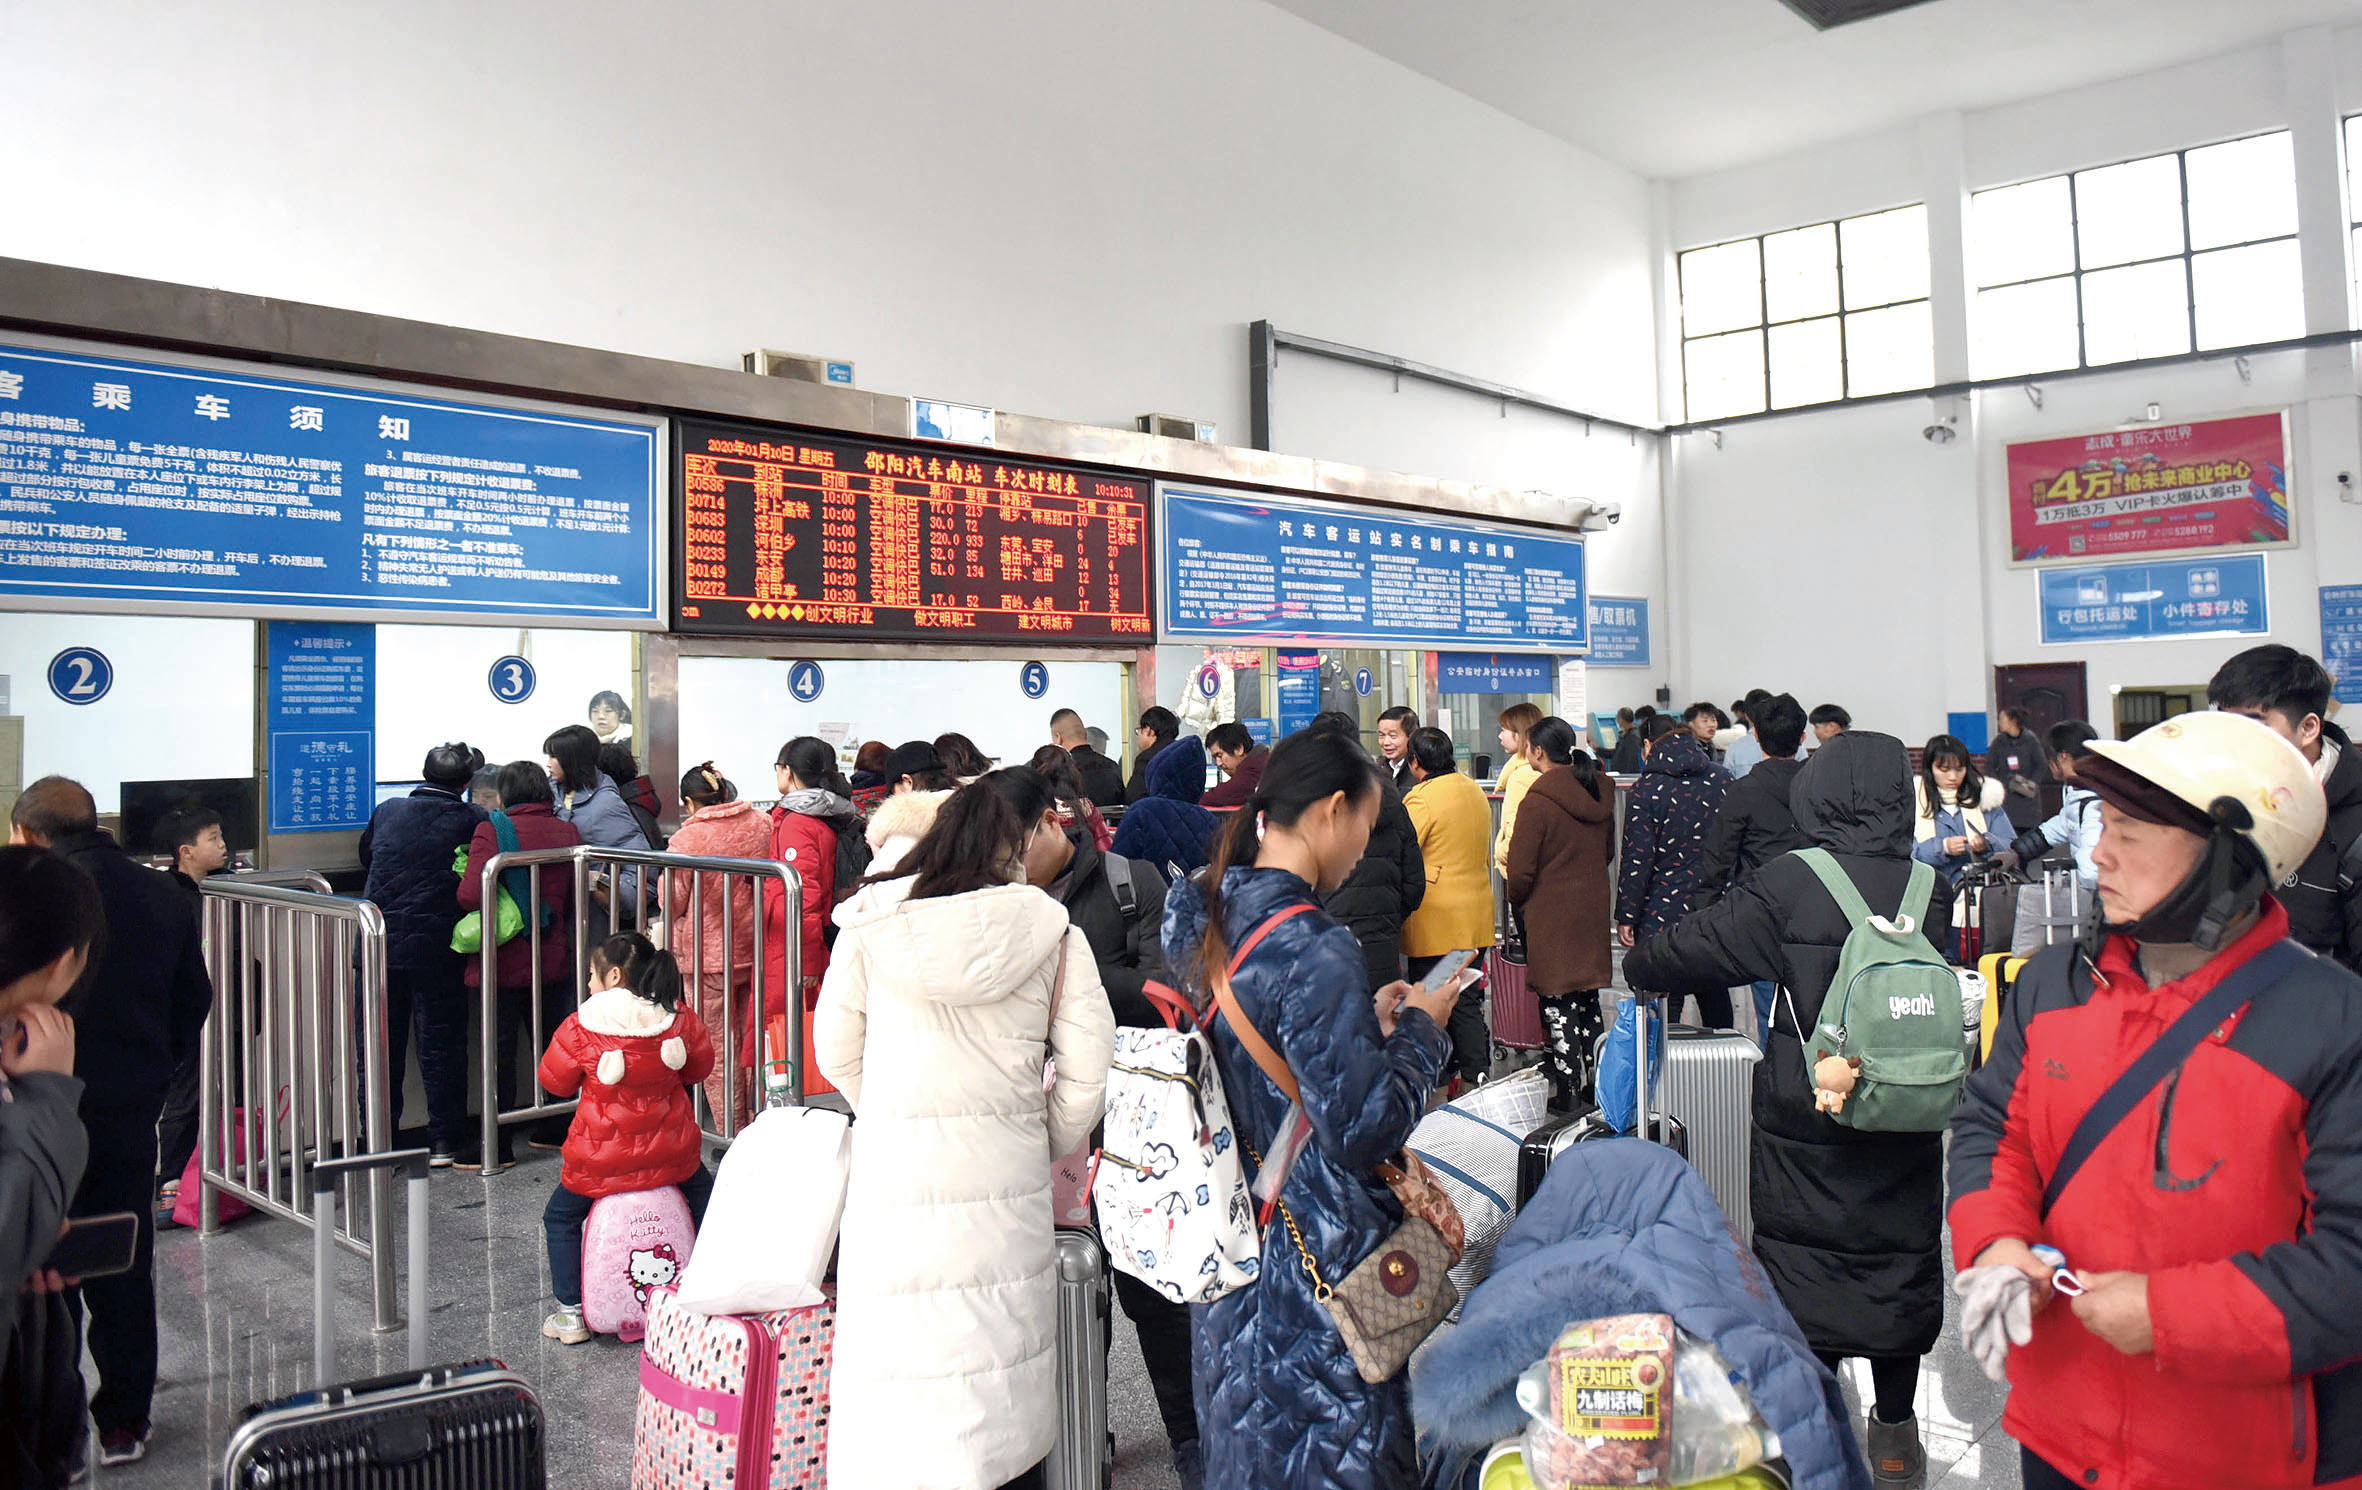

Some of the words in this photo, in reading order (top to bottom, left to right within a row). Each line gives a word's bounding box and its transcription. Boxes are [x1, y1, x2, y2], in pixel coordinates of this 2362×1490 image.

[707, 439, 796, 463] 2020年01月10日
[798, 447, 835, 468] 星期五
[687, 456, 718, 475] 车次
[821, 473, 849, 489] 时间
[868, 478, 895, 494] 车型
[928, 484, 954, 501] 票价
[965, 486, 988, 504] 里程
[864, 450, 983, 484] 邵阳汽车南站
[994, 465, 1080, 495] 车次时刻表
[687, 477, 727, 493] B0586
[821, 490, 857, 506] 10:00
[929, 501, 955, 515] 77.0
[965, 505, 984, 518] 213
[1076, 515, 1089, 527] 10
[1094, 483, 1134, 499] 10:10:31
[687, 493, 727, 511] B0714
[821, 506, 857, 522] 10:00
[929, 515, 955, 530] 30.0
[965, 520, 979, 533] 72
[687, 510, 727, 528] B0683
[754, 514, 784, 534] 深圳
[821, 522, 857, 538] 10:00
[929, 531, 961, 546] 220.0
[965, 535, 984, 548] 933
[1107, 545, 1119, 558] 20
[687, 527, 727, 545] B0602
[821, 538, 857, 554] 10:10
[930, 547, 955, 561] 32.0
[965, 549, 979, 562] 85
[1077, 557, 1089, 570] 24
[1107, 559, 1115, 572] 4
[1279, 520, 1515, 559] 汽车客运站实名制乘车指南
[687, 545, 727, 562] B0233
[822, 555, 858, 571] 10:20
[930, 562, 956, 576] 51.0
[966, 565, 985, 578] 134
[1078, 572, 1090, 585] 12
[1108, 573, 1120, 586] 13
[687, 562, 728, 580] B0149
[755, 566, 785, 585] 成都
[822, 571, 858, 587] 10:20
[1108, 587, 1120, 600] 34
[687, 580, 727, 596] B0272
[822, 587, 858, 602] 10:30
[930, 593, 956, 607] 17.0
[966, 595, 980, 608] 52
[1078, 600, 1090, 612] 17
[805, 605, 874, 625] 创文明行业
[914, 609, 976, 627] 做文明职工
[1018, 614, 1073, 632] 建文明城市
[67, 657, 97, 694] 2
[501, 664, 524, 696] 3
[797, 668, 814, 695] 4
[1028, 668, 1041, 693] 5
[1203, 671, 1215, 694] 6
[1359, 671, 1368, 692] 7
[1888, 993, 1936, 1021] yeah!
[629, 1210, 661, 1226] Hello
[630, 1225, 666, 1240] Kitty
[1577, 1388, 1645, 1411] 九制话梅
